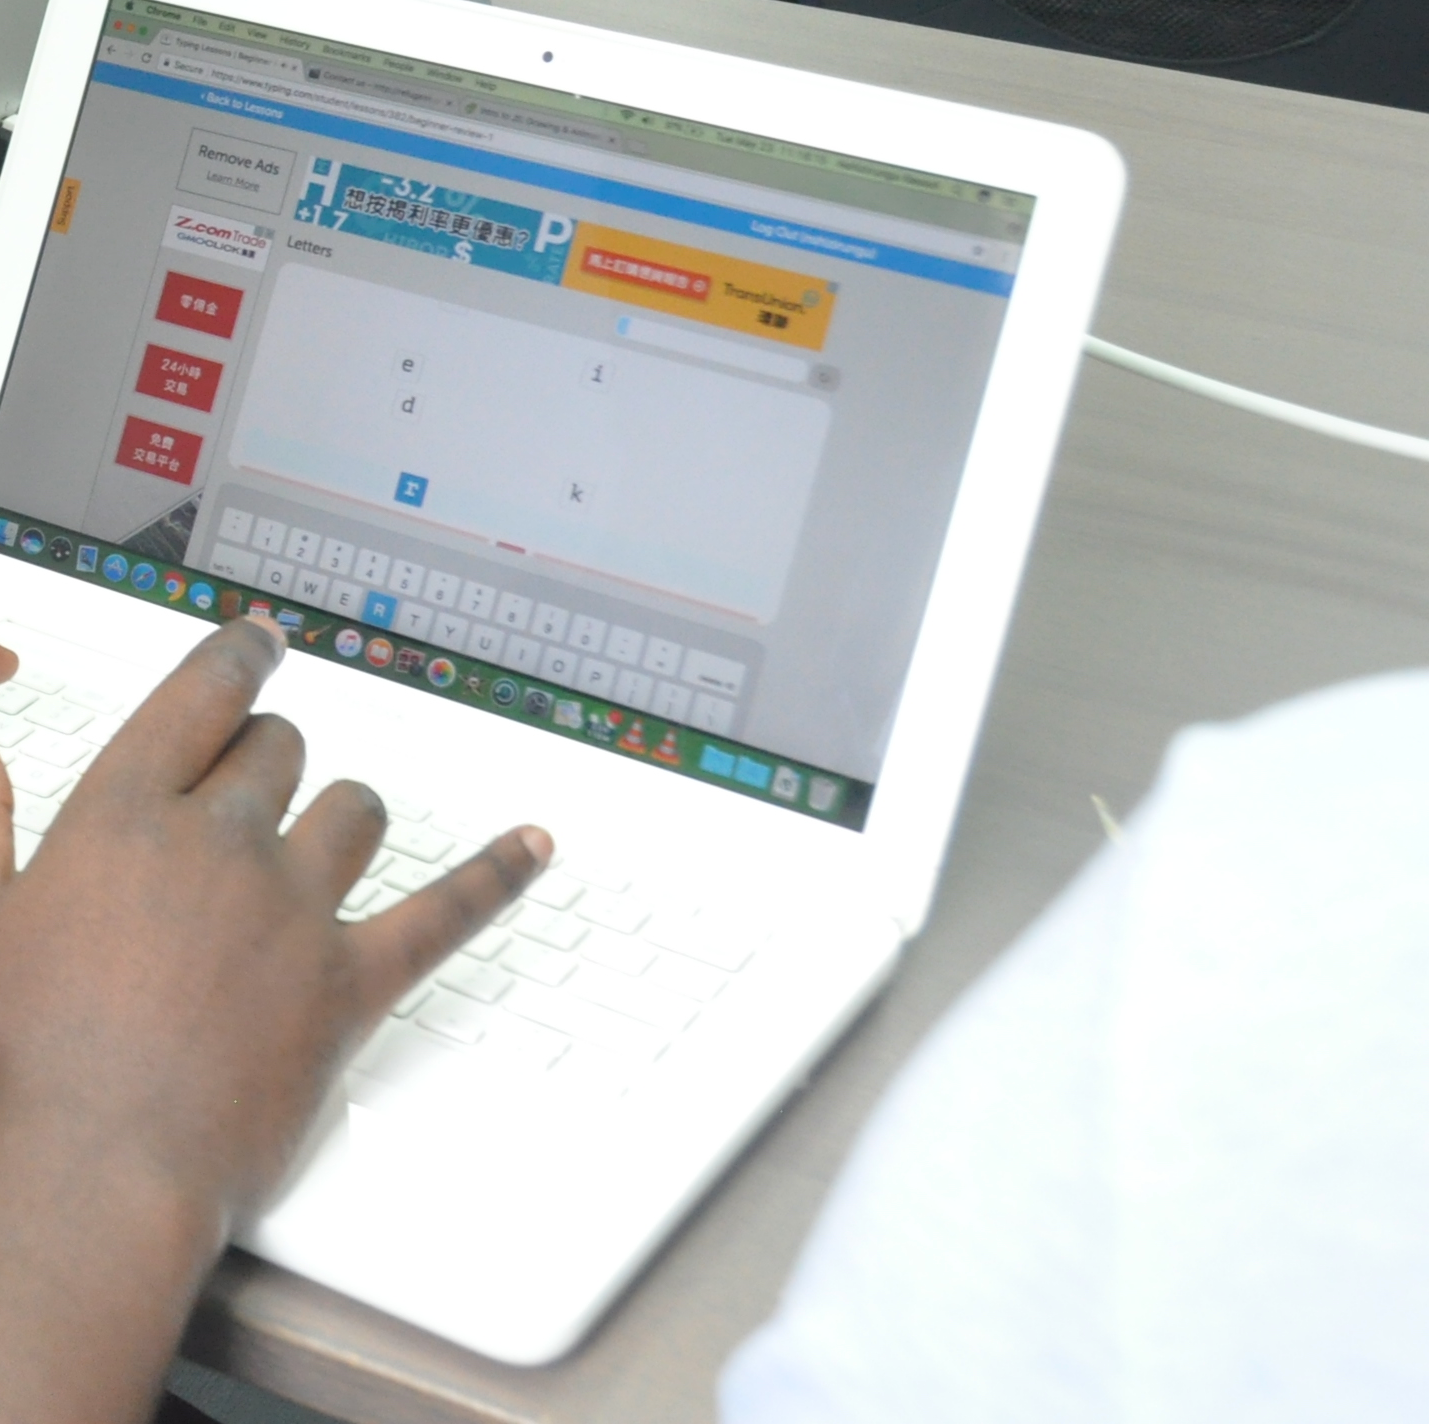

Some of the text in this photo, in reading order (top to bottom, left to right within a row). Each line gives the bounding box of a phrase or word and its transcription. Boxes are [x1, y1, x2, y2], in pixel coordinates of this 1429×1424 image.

[146, 4, 182, 21] Chrome
[192, 15, 209, 26] File
[218, 21, 236, 34] Edit
[246, 27, 268, 40] View
[279, 34, 312, 51] History
[322, 44, 373, 64] Bookmarks
[383, 57, 415, 73] People
[474, 77, 498, 92] Help
[175, 37, 200, 51] Typing
[201, 43, 232, 58] Lessons
[174, 60, 204, 75] Secure
[323, 71, 355, 85] Contact
[206, 92, 284, 119] Back to Lessons
[197, 144, 281, 176] Remove Ads
[206, 171, 261, 193] Learn More
[174, 214, 267, 249] Z.com Trade
[286, 233, 334, 260] Letters
[160, 357, 202, 381] 24小時
[402, 358, 415, 373] e
[591, 363, 605, 384] i
[163, 378, 189, 397] 交易
[400, 395, 417, 414] d
[149, 432, 176, 452] 免費
[132, 447, 181, 473] 交易平台
[404, 480, 421, 497] r
[570, 482, 585, 504] k
[264, 537, 271, 549] 1
[296, 546, 307, 559] 2
[329, 556, 340, 570] 3
[364, 568, 375, 581] 4
[399, 578, 410, 592] 5
[434, 589, 444, 603] 6
[470, 600, 481, 613] 7
[269, 570, 283, 587] Q
[302, 581, 319, 596] W
[339, 591, 350, 607] E
[372, 602, 386, 618] R
[409, 614, 422, 628] T
[444, 624, 458, 639] Y
[478, 635, 492, 651] U
[518, 647, 524, 662] I
[552, 657, 567, 674] O
[590, 670, 603, 685] P
